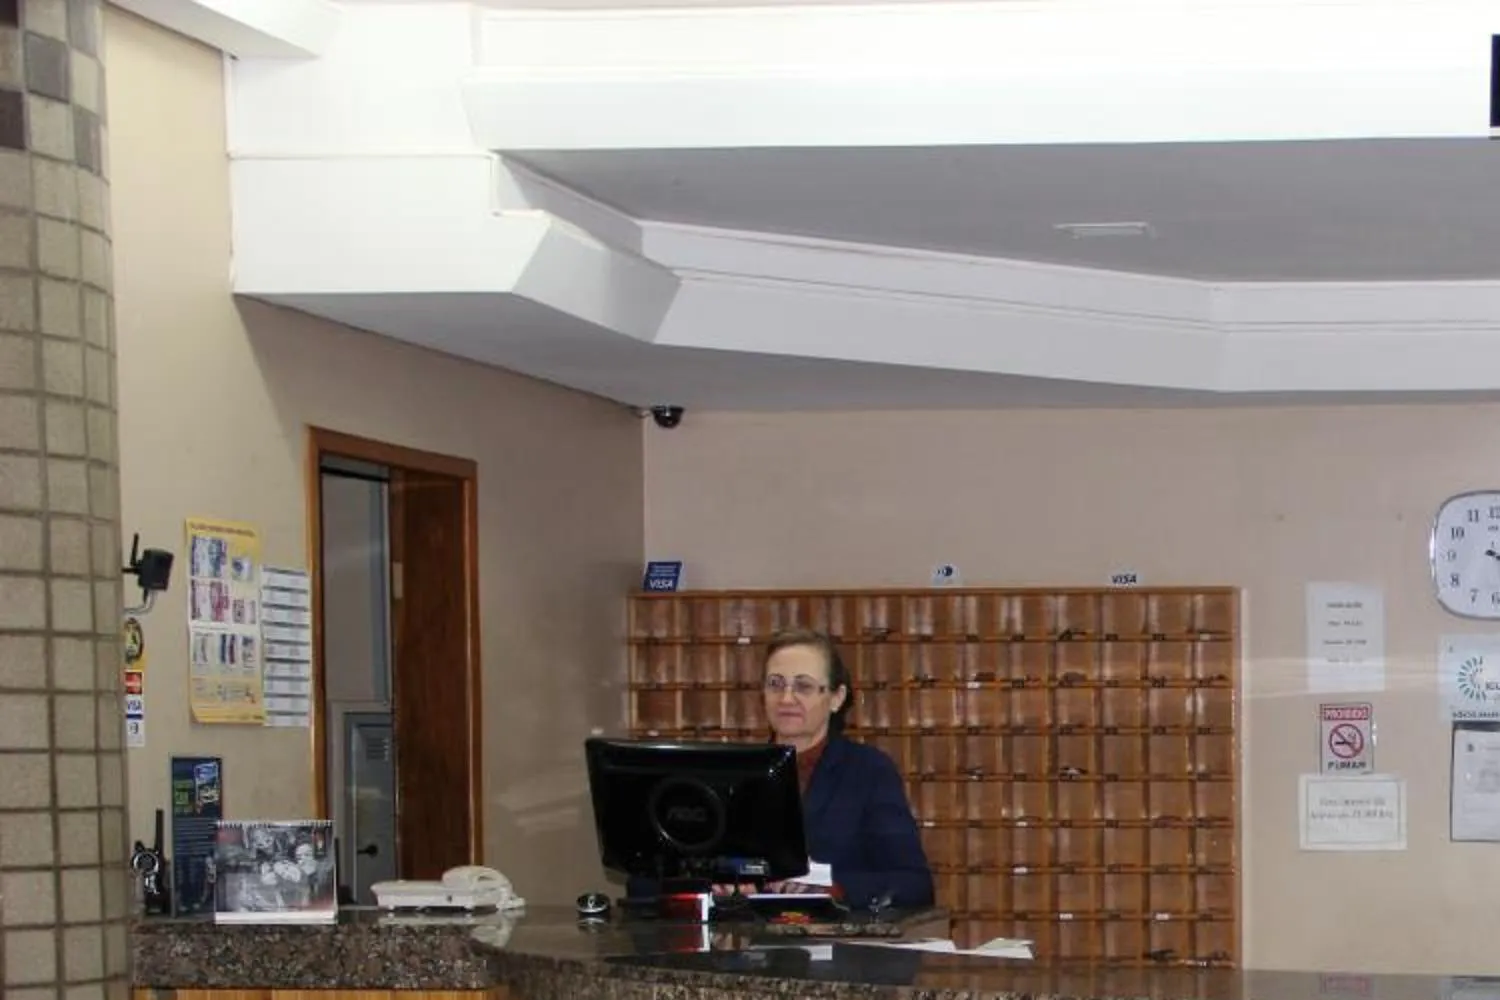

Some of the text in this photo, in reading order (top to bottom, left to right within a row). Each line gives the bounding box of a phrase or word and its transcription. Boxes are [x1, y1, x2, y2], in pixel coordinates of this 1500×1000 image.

[1468, 509, 1479, 523] 11
[1451, 526, 1465, 541] 10
[649, 579, 673, 589] VISA
[1111, 574, 1137, 585] VISA
[1450, 573, 1459, 587] 8
[1470, 588, 1479, 603] 7
[1491, 591, 1500, 604] 6
